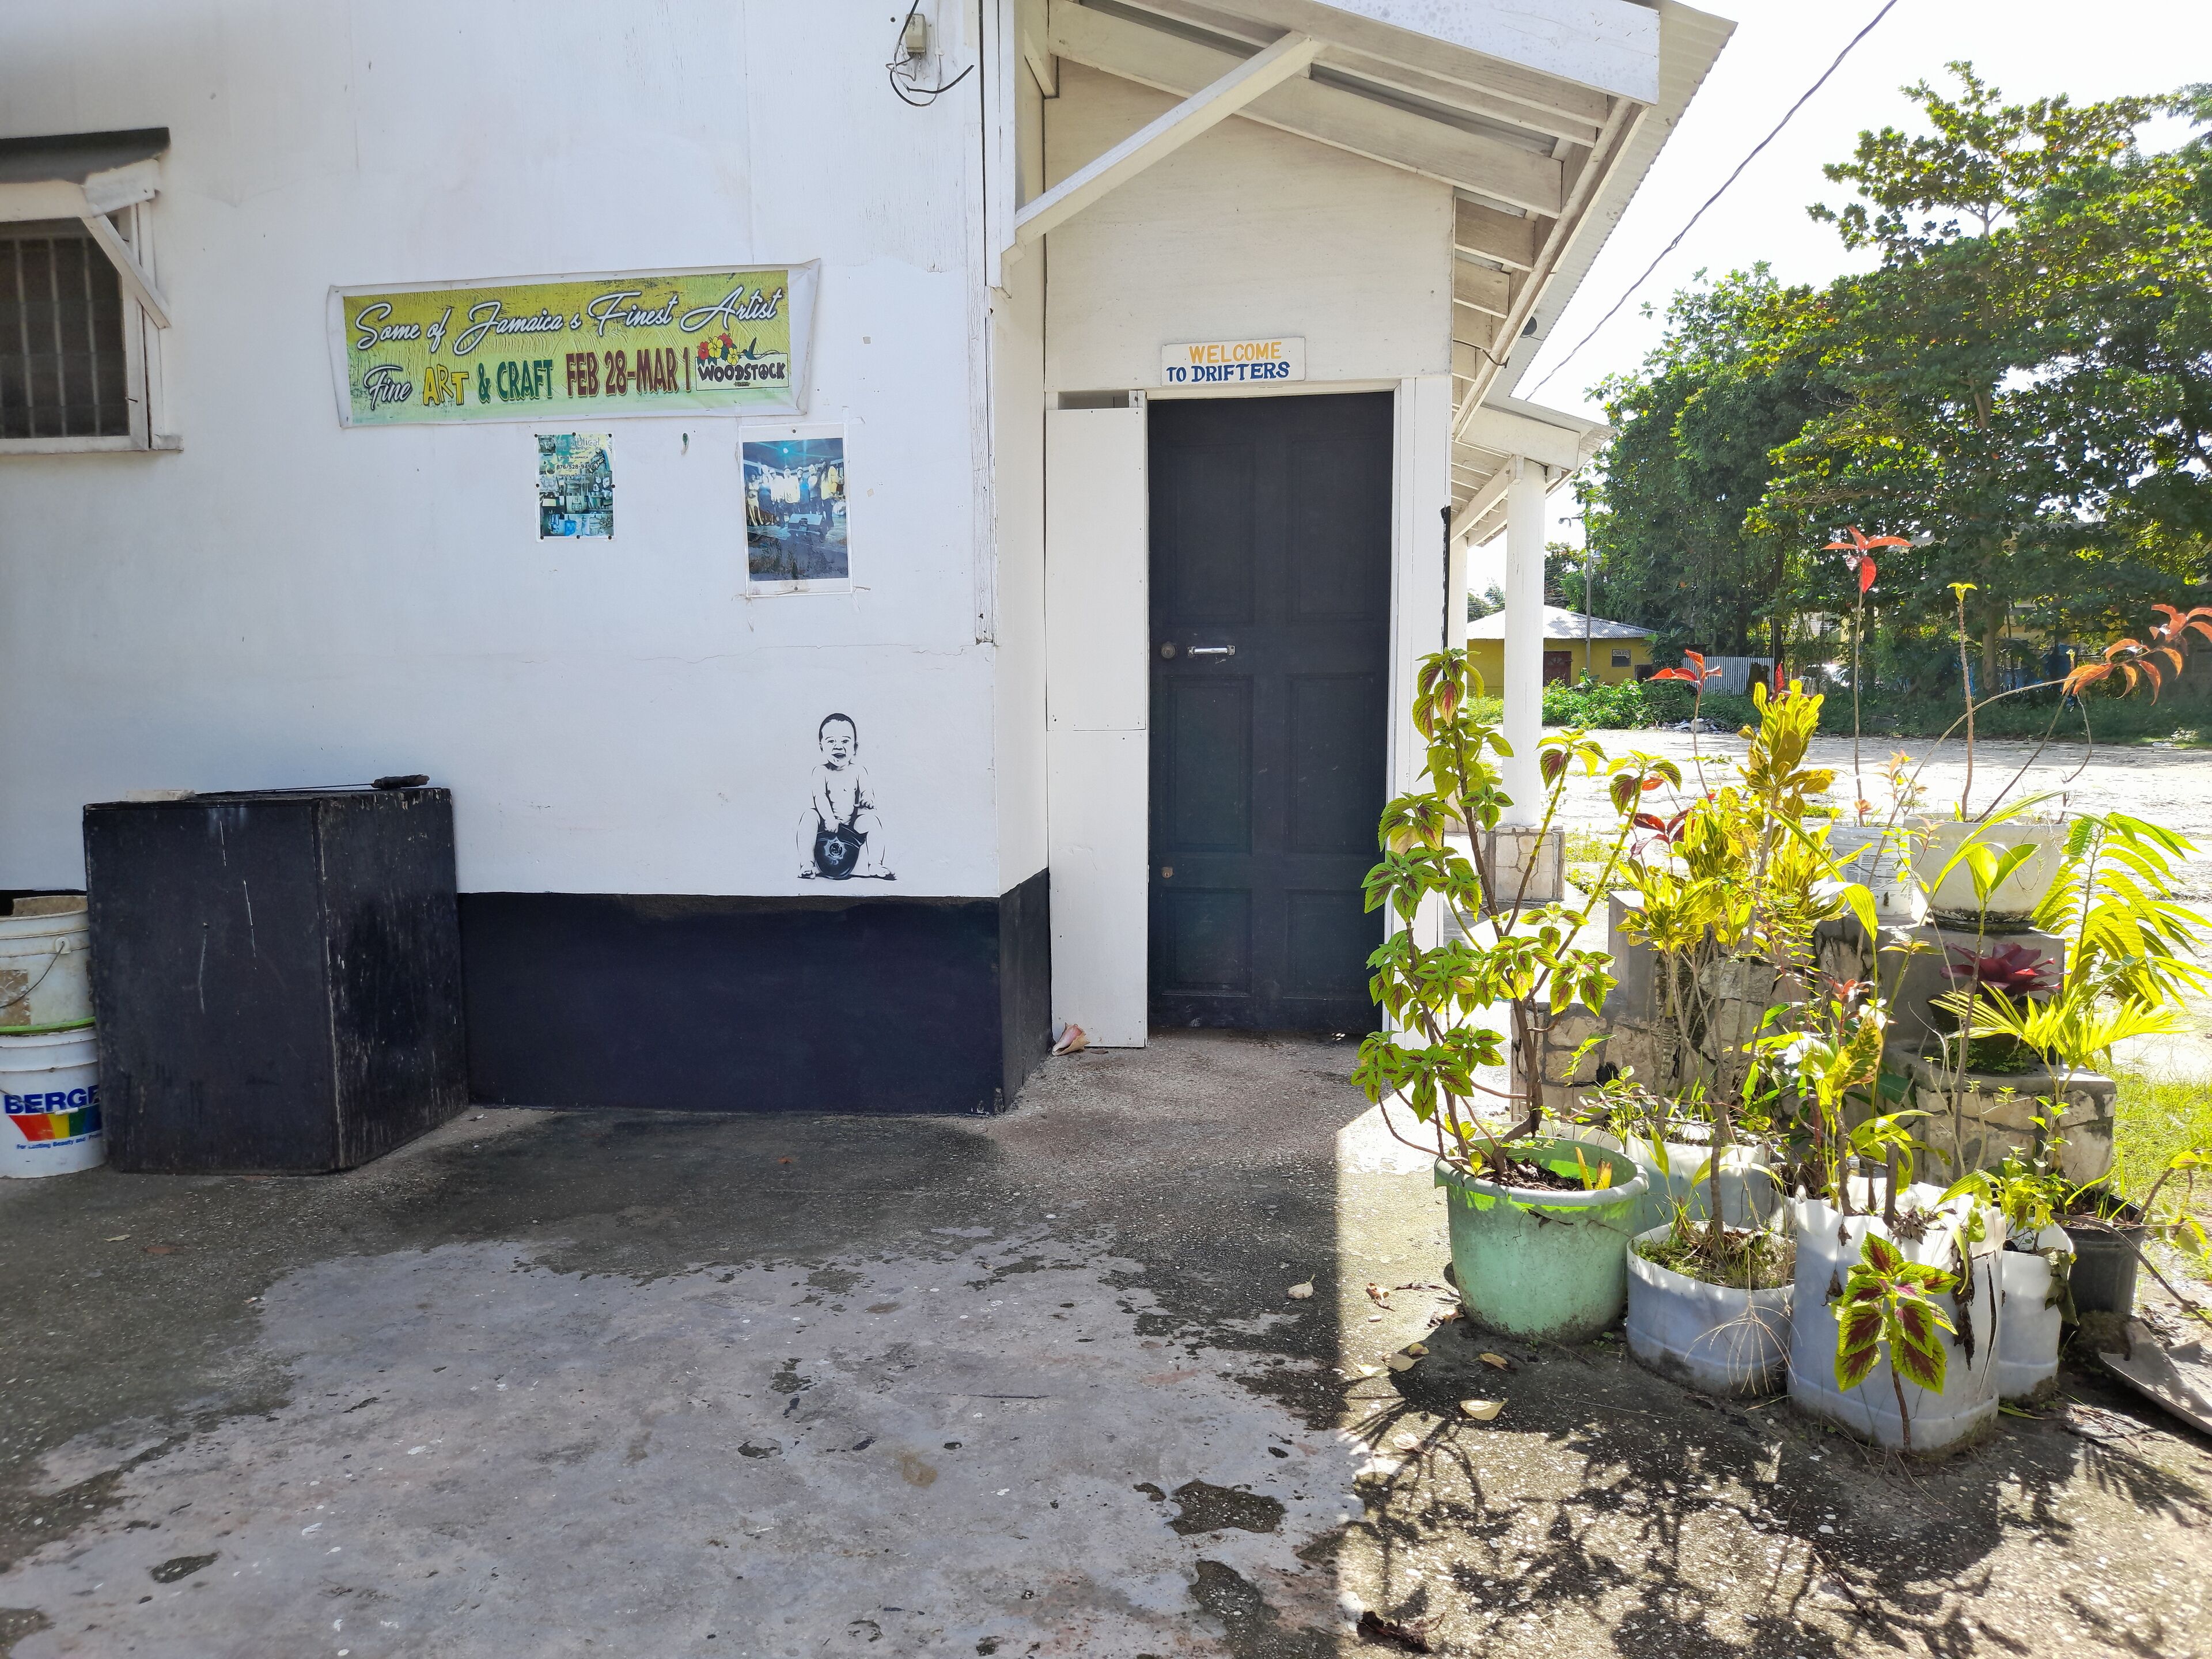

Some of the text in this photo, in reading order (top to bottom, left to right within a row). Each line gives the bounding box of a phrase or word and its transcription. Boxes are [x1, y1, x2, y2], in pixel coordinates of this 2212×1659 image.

[355, 302, 421, 350] Some
[427, 308, 452, 353] of
[453, 301, 563, 355] Jamaica
[588, 291, 679, 336] Finest
[680, 286, 782, 332] Artist
[1189, 341, 1282, 364] WELCOME
[363, 347, 691, 410] Fine ART & CRAFT FEB 28-MAR 1
[697, 362, 786, 382] WOODSTOCK
[1166, 361, 1290, 382] TO DRIFTERS
